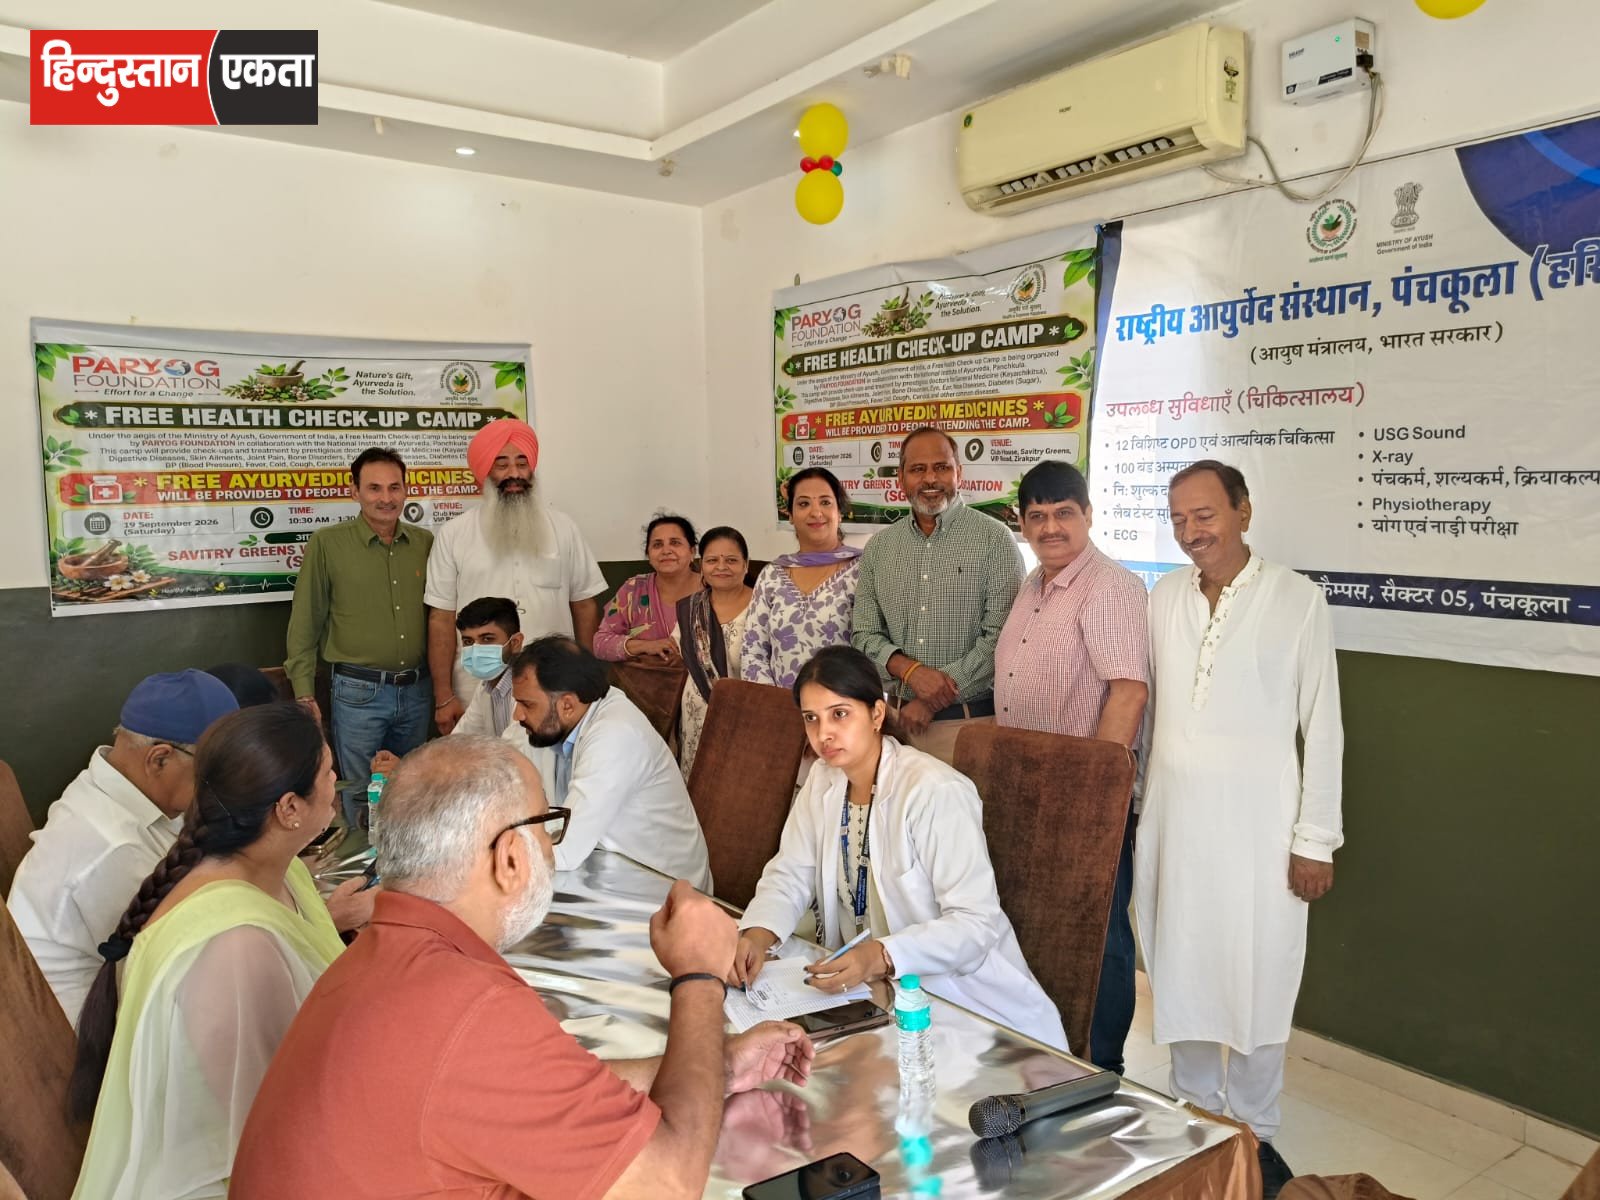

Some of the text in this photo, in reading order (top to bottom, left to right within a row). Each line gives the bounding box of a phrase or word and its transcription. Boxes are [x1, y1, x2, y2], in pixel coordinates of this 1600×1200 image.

[1376, 233, 1433, 248] MINISTRY AYUSH
[1376, 241, 1433, 255] Government India
[1116, 304, 1185, 345] राष्ट्रीय
[1189, 287, 1276, 338] आयुर्वेद
[1279, 281, 1382, 321] संस्थान,
[1391, 260, 1519, 314] पंचकूला
[791, 303, 862, 331] PARYOG
[940, 306, 981, 318] the Solution.
[791, 321, 860, 342] FOUNDATION
[803, 323, 1044, 373] FREE HEALTH CHECK-UP CAMP
[1250, 321, 1504, 365] (आयुष मंत्रालय, भारत सरकार)
[72, 356, 220, 376] PARYOG
[74, 375, 220, 389] FOUNDATION
[353, 379, 404, 388] Ayurveda is
[355, 371, 414, 381] Nature's Gift,
[158, 390, 194, 398] Change
[361, 387, 416, 396] the Solution.
[1105, 382, 1365, 420] उपलब्ध सुविधाएँ (चिकित्सालय)
[105, 406, 482, 428] FREE HEALTH CHECK-UP CAMP
[825, 399, 1028, 427] FREE AYURVEDIC MEDICINES
[825, 417, 1031, 437] WILL BE PROVIDED TO THE CAMP.
[1373, 425, 1466, 441] USG Sound
[1115, 440, 1129, 451] 12
[1170, 438, 1197, 449] OPD
[1199, 433, 1219, 451] एवं
[1278, 428, 1335, 446] चिकित्सा
[1020, 448, 1044, 456] Savitry
[1372, 450, 1413, 466] X-ray
[1114, 463, 1135, 474] 100
[156, 474, 222, 489] FREE
[1371, 467, 1431, 487] पंचकर्म,
[1434, 465, 1510, 488] शल्यकर्म,
[157, 485, 480, 501] WILL BE PROVIDED TO PEOPLE THE CAMP.
[1130, 485, 1159, 500] शुल्क
[288, 506, 314, 514] TIME:
[433, 502, 463, 510] VENUE:
[1112, 504, 1155, 519] लैब टेस्ट
[1372, 497, 1491, 515] Physiotherapy
[123, 512, 154, 520] DATE:
[123, 528, 176, 536] (Saturday)
[138, 520, 192, 529] September
[1371, 515, 1520, 539] योग एवं नाड़ी परीक्षा
[1113, 529, 1138, 541] ECG
[167, 545, 296, 561] SAVITRY GREENS
[1380, 578, 1434, 606] सैक्टर
[1440, 588, 1475, 611] 05,
[1481, 586, 1570, 617] पंचकूला
